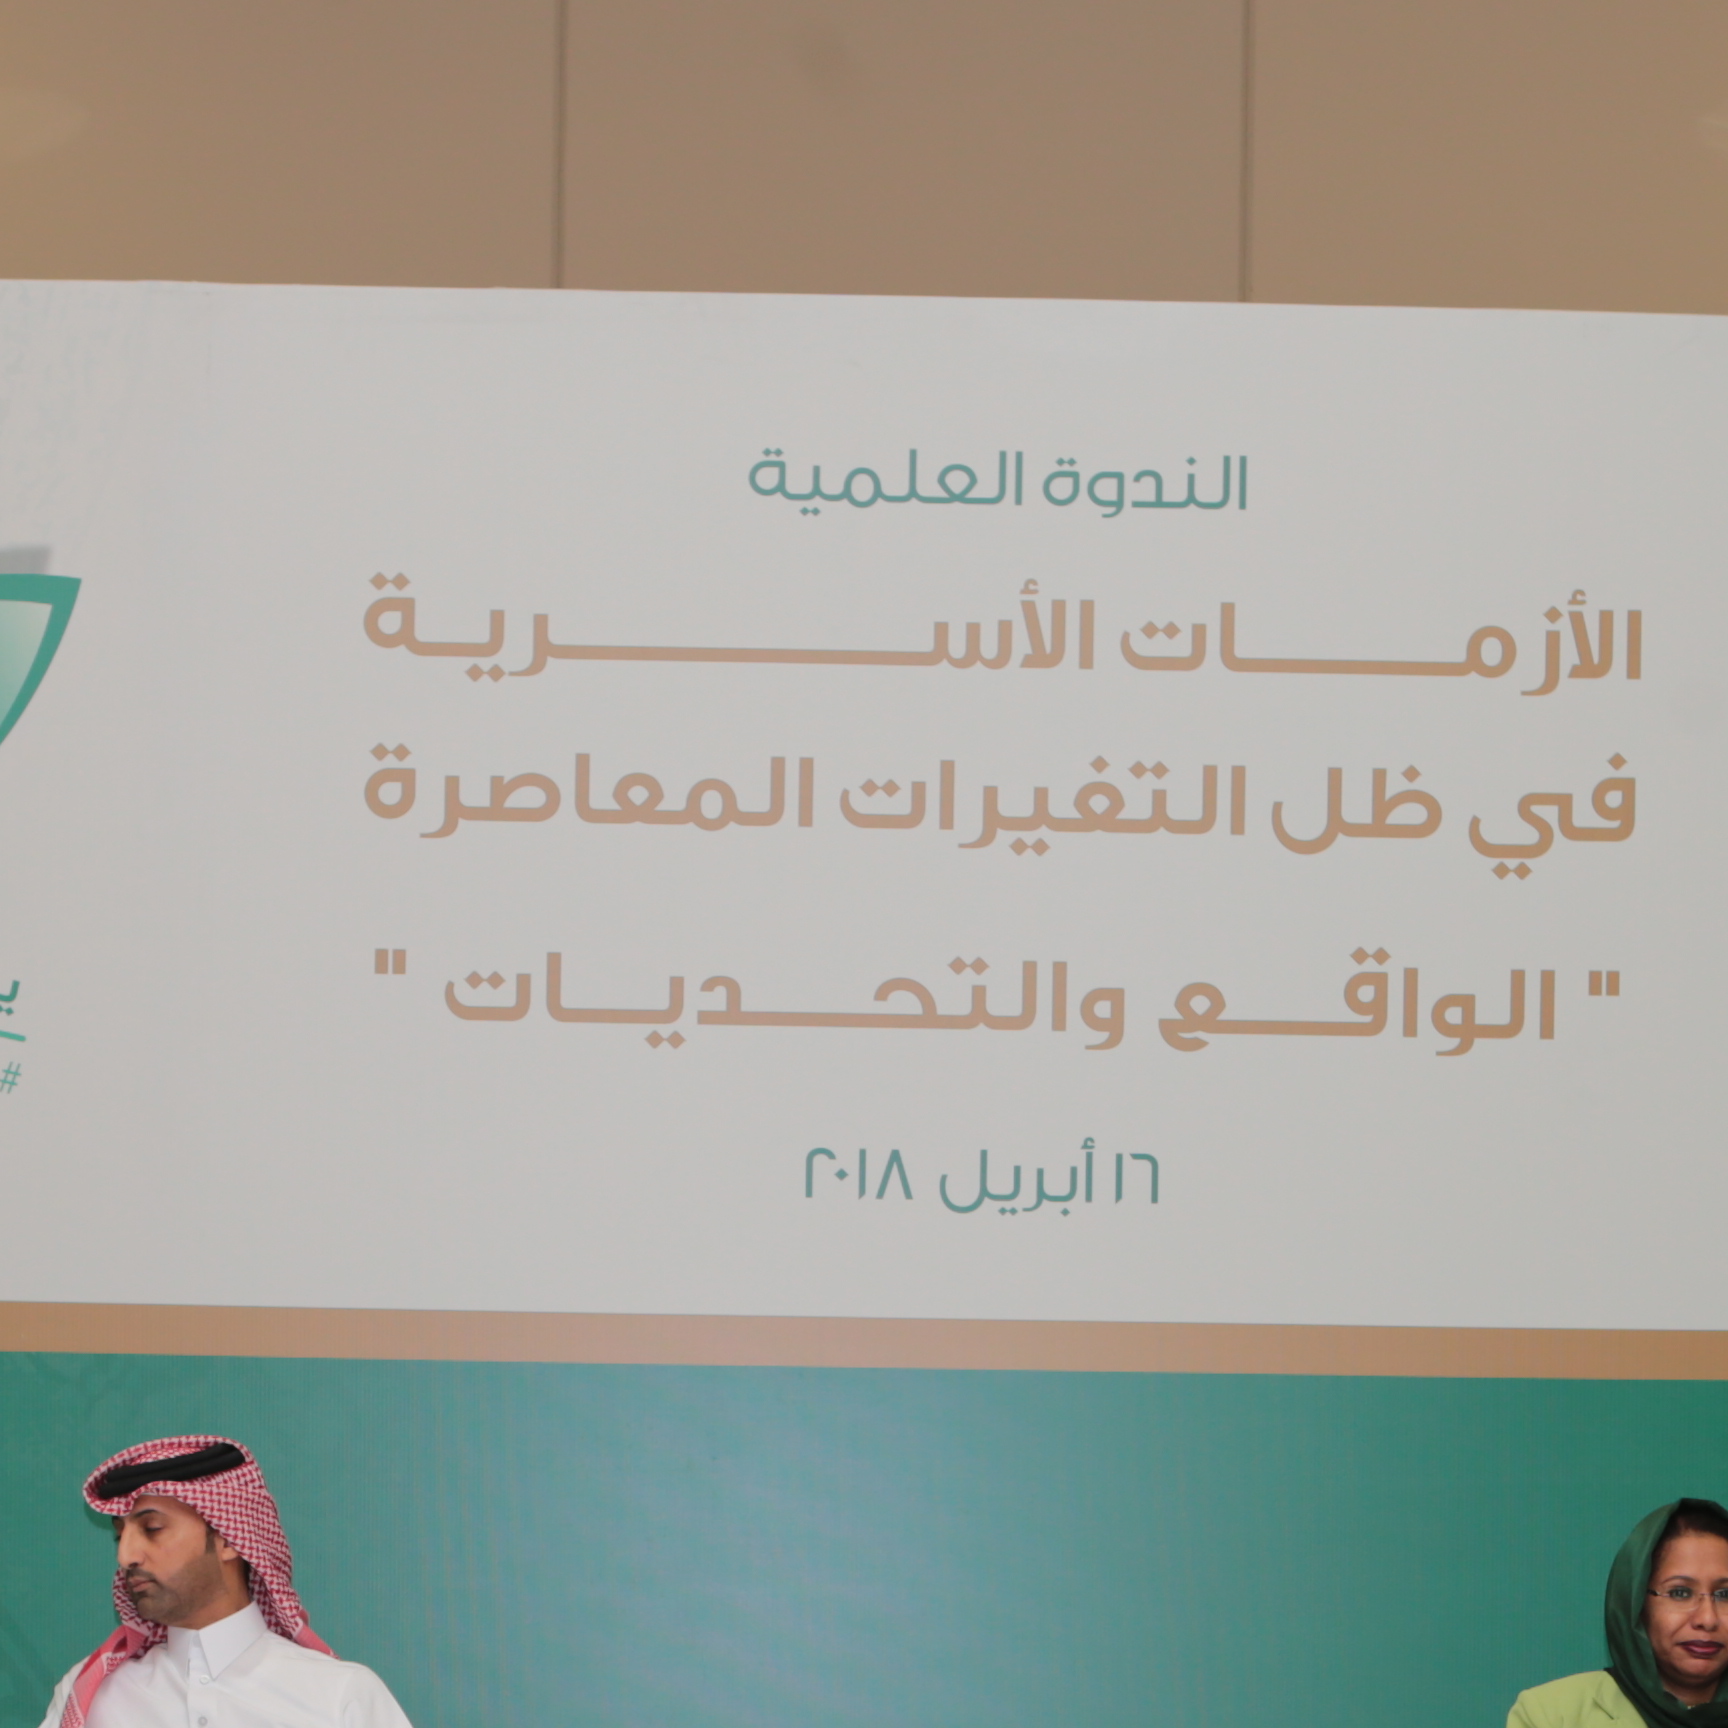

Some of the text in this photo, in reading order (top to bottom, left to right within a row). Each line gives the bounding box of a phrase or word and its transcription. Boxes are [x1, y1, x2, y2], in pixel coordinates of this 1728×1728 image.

[747, 447, 1248, 519] الندوة العلمية
[362, 571, 1643, 697] الأزمات الأسرية
[363, 742, 1638, 881] في ظل التغيرات المعاصرة
[443, 951, 1126, 1051] والتحديات
[1158, 946, 1556, 1057] الواقع
[939, 1136, 1097, 1217] أبريل
